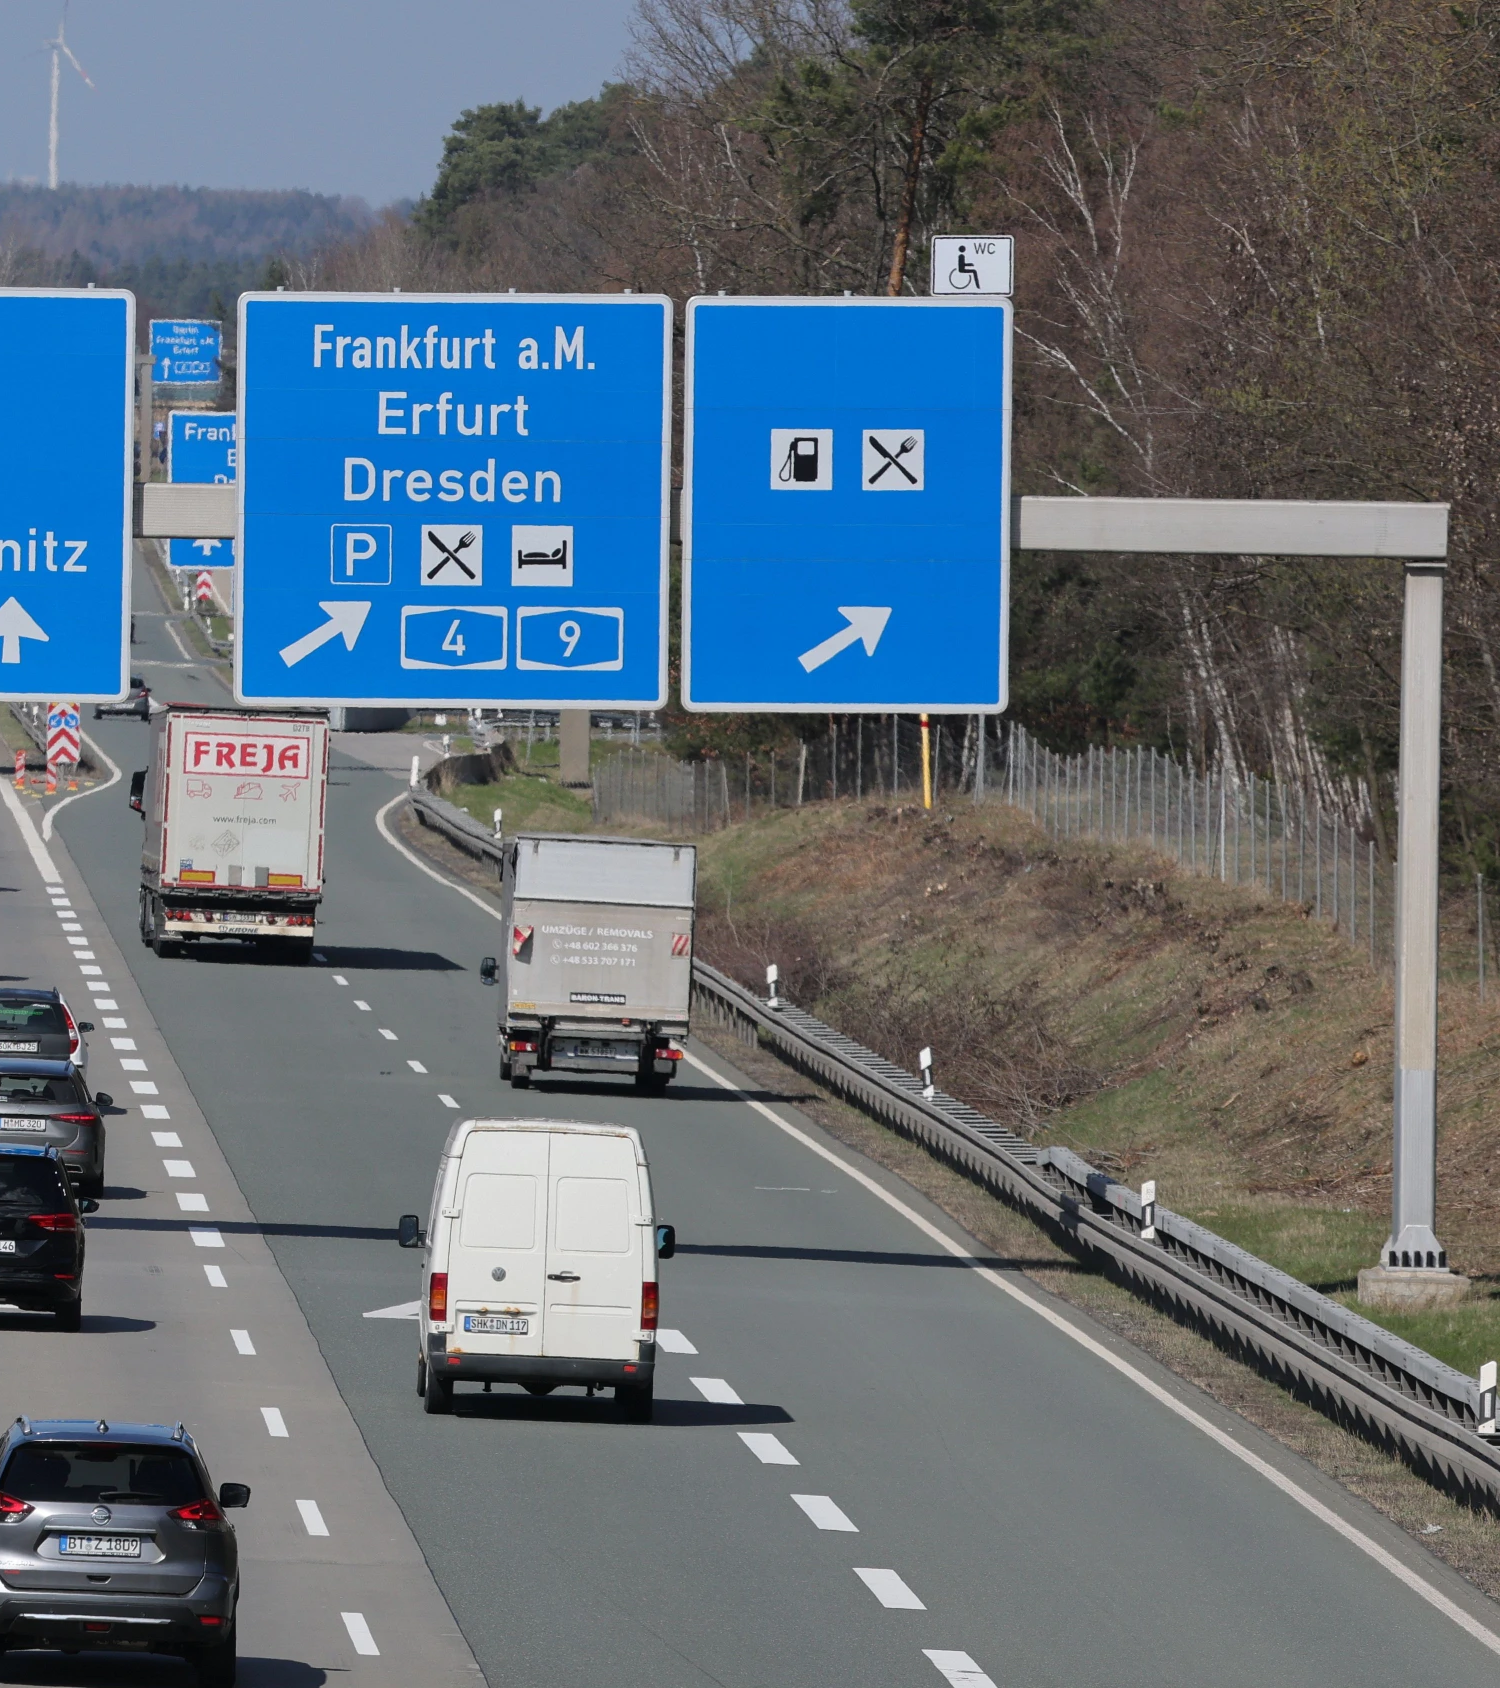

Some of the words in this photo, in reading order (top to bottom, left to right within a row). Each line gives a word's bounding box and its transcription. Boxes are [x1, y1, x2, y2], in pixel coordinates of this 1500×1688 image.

[973, 242, 996, 255] WC
[315, 325, 495, 368] Frankfurt
[519, 327, 594, 369] a.M.
[379, 392, 528, 435] Erfurt
[184, 422, 236, 441] Fran
[345, 458, 560, 502] Dresden
[346, 533, 376, 575] P
[443, 620, 465, 655] 4
[560, 621, 580, 656] 9
[194, 741, 300, 773] FREJA
[212, 815, 276, 825] www.freja.com
[542, 924, 587, 936] UMZÜGE
[588, 928, 594, 936] /
[597, 928, 654, 940] REMOVALS
[564, 942, 581, 950] +48
[582, 942, 600, 950] 602
[620, 944, 638, 952] 376
[582, 956, 598, 964] 533
[600, 957, 618, 965] 707
[620, 958, 636, 966] 171
[571, 994, 624, 1003] BARON-TRANS
[471, 1319, 489, 1329] SHK
[496, 1320, 507, 1330] DN
[510, 1321, 526, 1331] 117
[68, 1537, 86, 1549] BT
[95, 1538, 102, 1550] Z
[107, 1538, 138, 1551] 1809
